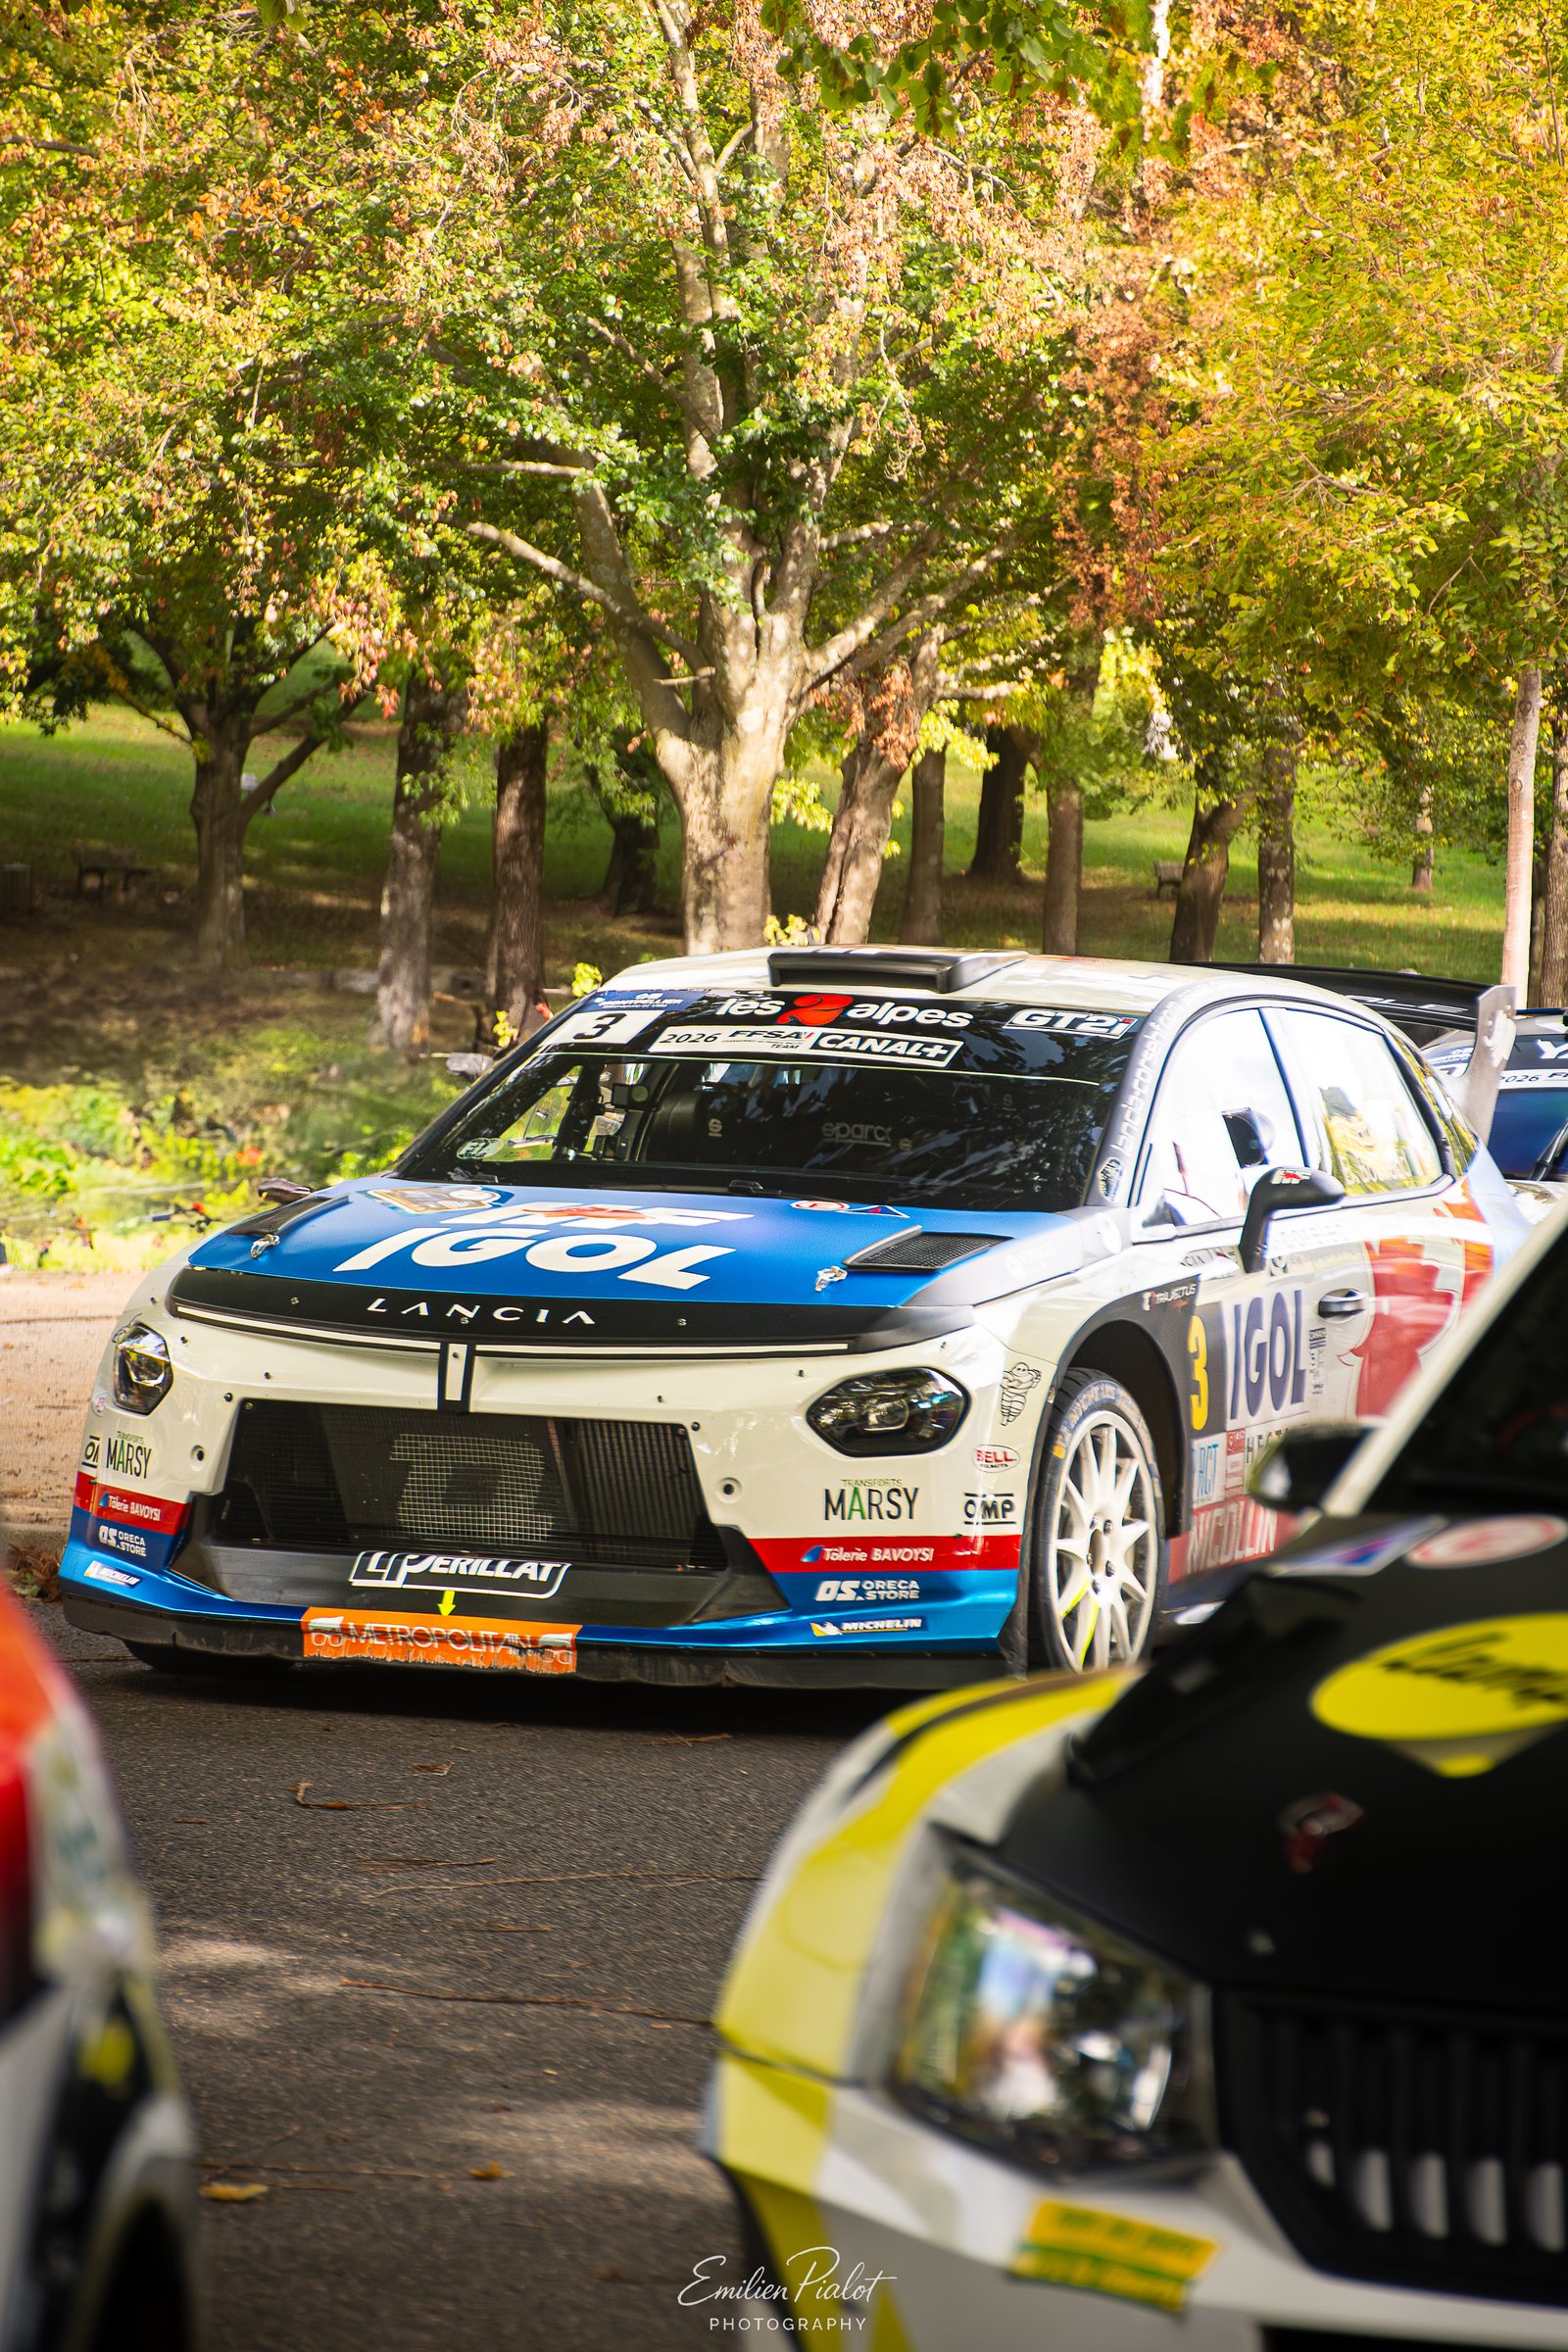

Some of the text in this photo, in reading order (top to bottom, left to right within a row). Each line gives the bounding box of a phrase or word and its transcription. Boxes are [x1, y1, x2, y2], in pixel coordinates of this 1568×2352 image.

[714, 998, 786, 1016] les
[846, 1000, 975, 1028] alpes
[1011, 1009, 1135, 1037] GT2i
[572, 1012, 628, 1040] 3
[728, 1030, 804, 1040] FFSA
[659, 1032, 718, 1044] 2026
[818, 1033, 949, 1058] CANAL+
[1537, 1039, 1568, 1059] Y
[332, 1227, 737, 1291] IGOL
[366, 1298, 596, 1325] LANCIA
[1230, 1289, 1306, 1421] IGOL
[1186, 1315, 1210, 1431] 3
[106, 1437, 152, 1479] MARSY
[975, 1449, 1014, 1463] BELL
[841, 1478, 903, 1488] TRANSPORTS
[824, 1487, 920, 1520] MARSY
[963, 1498, 1015, 1520] OMP
[118, 1531, 146, 1546] ORECA
[120, 1542, 147, 1557] STORE
[871, 1547, 935, 1562] BAVOYSI
[861, 1579, 920, 1591] ORECA
[864, 1590, 920, 1601] STORE
[842, 1618, 922, 1631] MICHELIN
